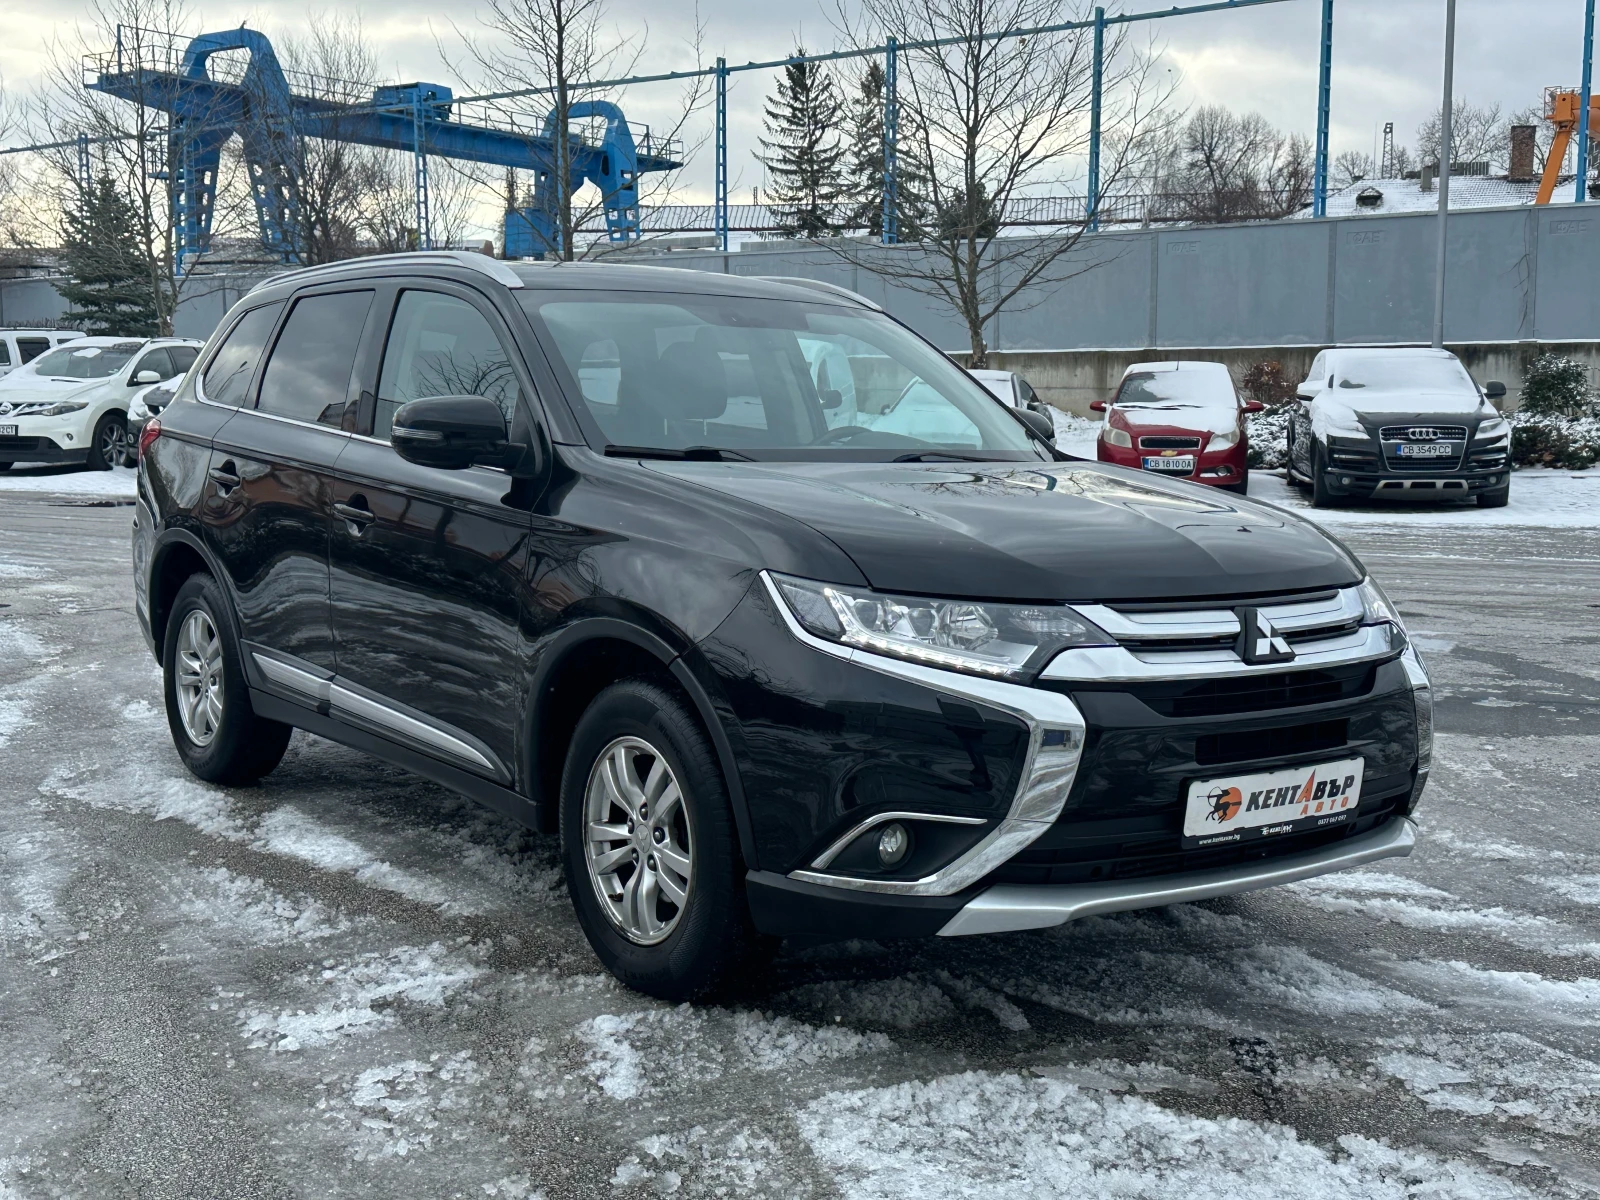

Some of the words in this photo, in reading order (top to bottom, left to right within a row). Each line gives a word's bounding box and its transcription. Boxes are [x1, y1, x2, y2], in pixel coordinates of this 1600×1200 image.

[1402, 446, 1415, 454] CB
[1416, 446, 1437, 454] 3549
[1438, 446, 1451, 454] CC
[1149, 460, 1160, 468] CB
[1162, 460, 1180, 468] 1810
[1181, 460, 1192, 468] OA
[1245, 768, 1355, 812] КЕНТАВЪР
[1300, 796, 1349, 816] АВТО
